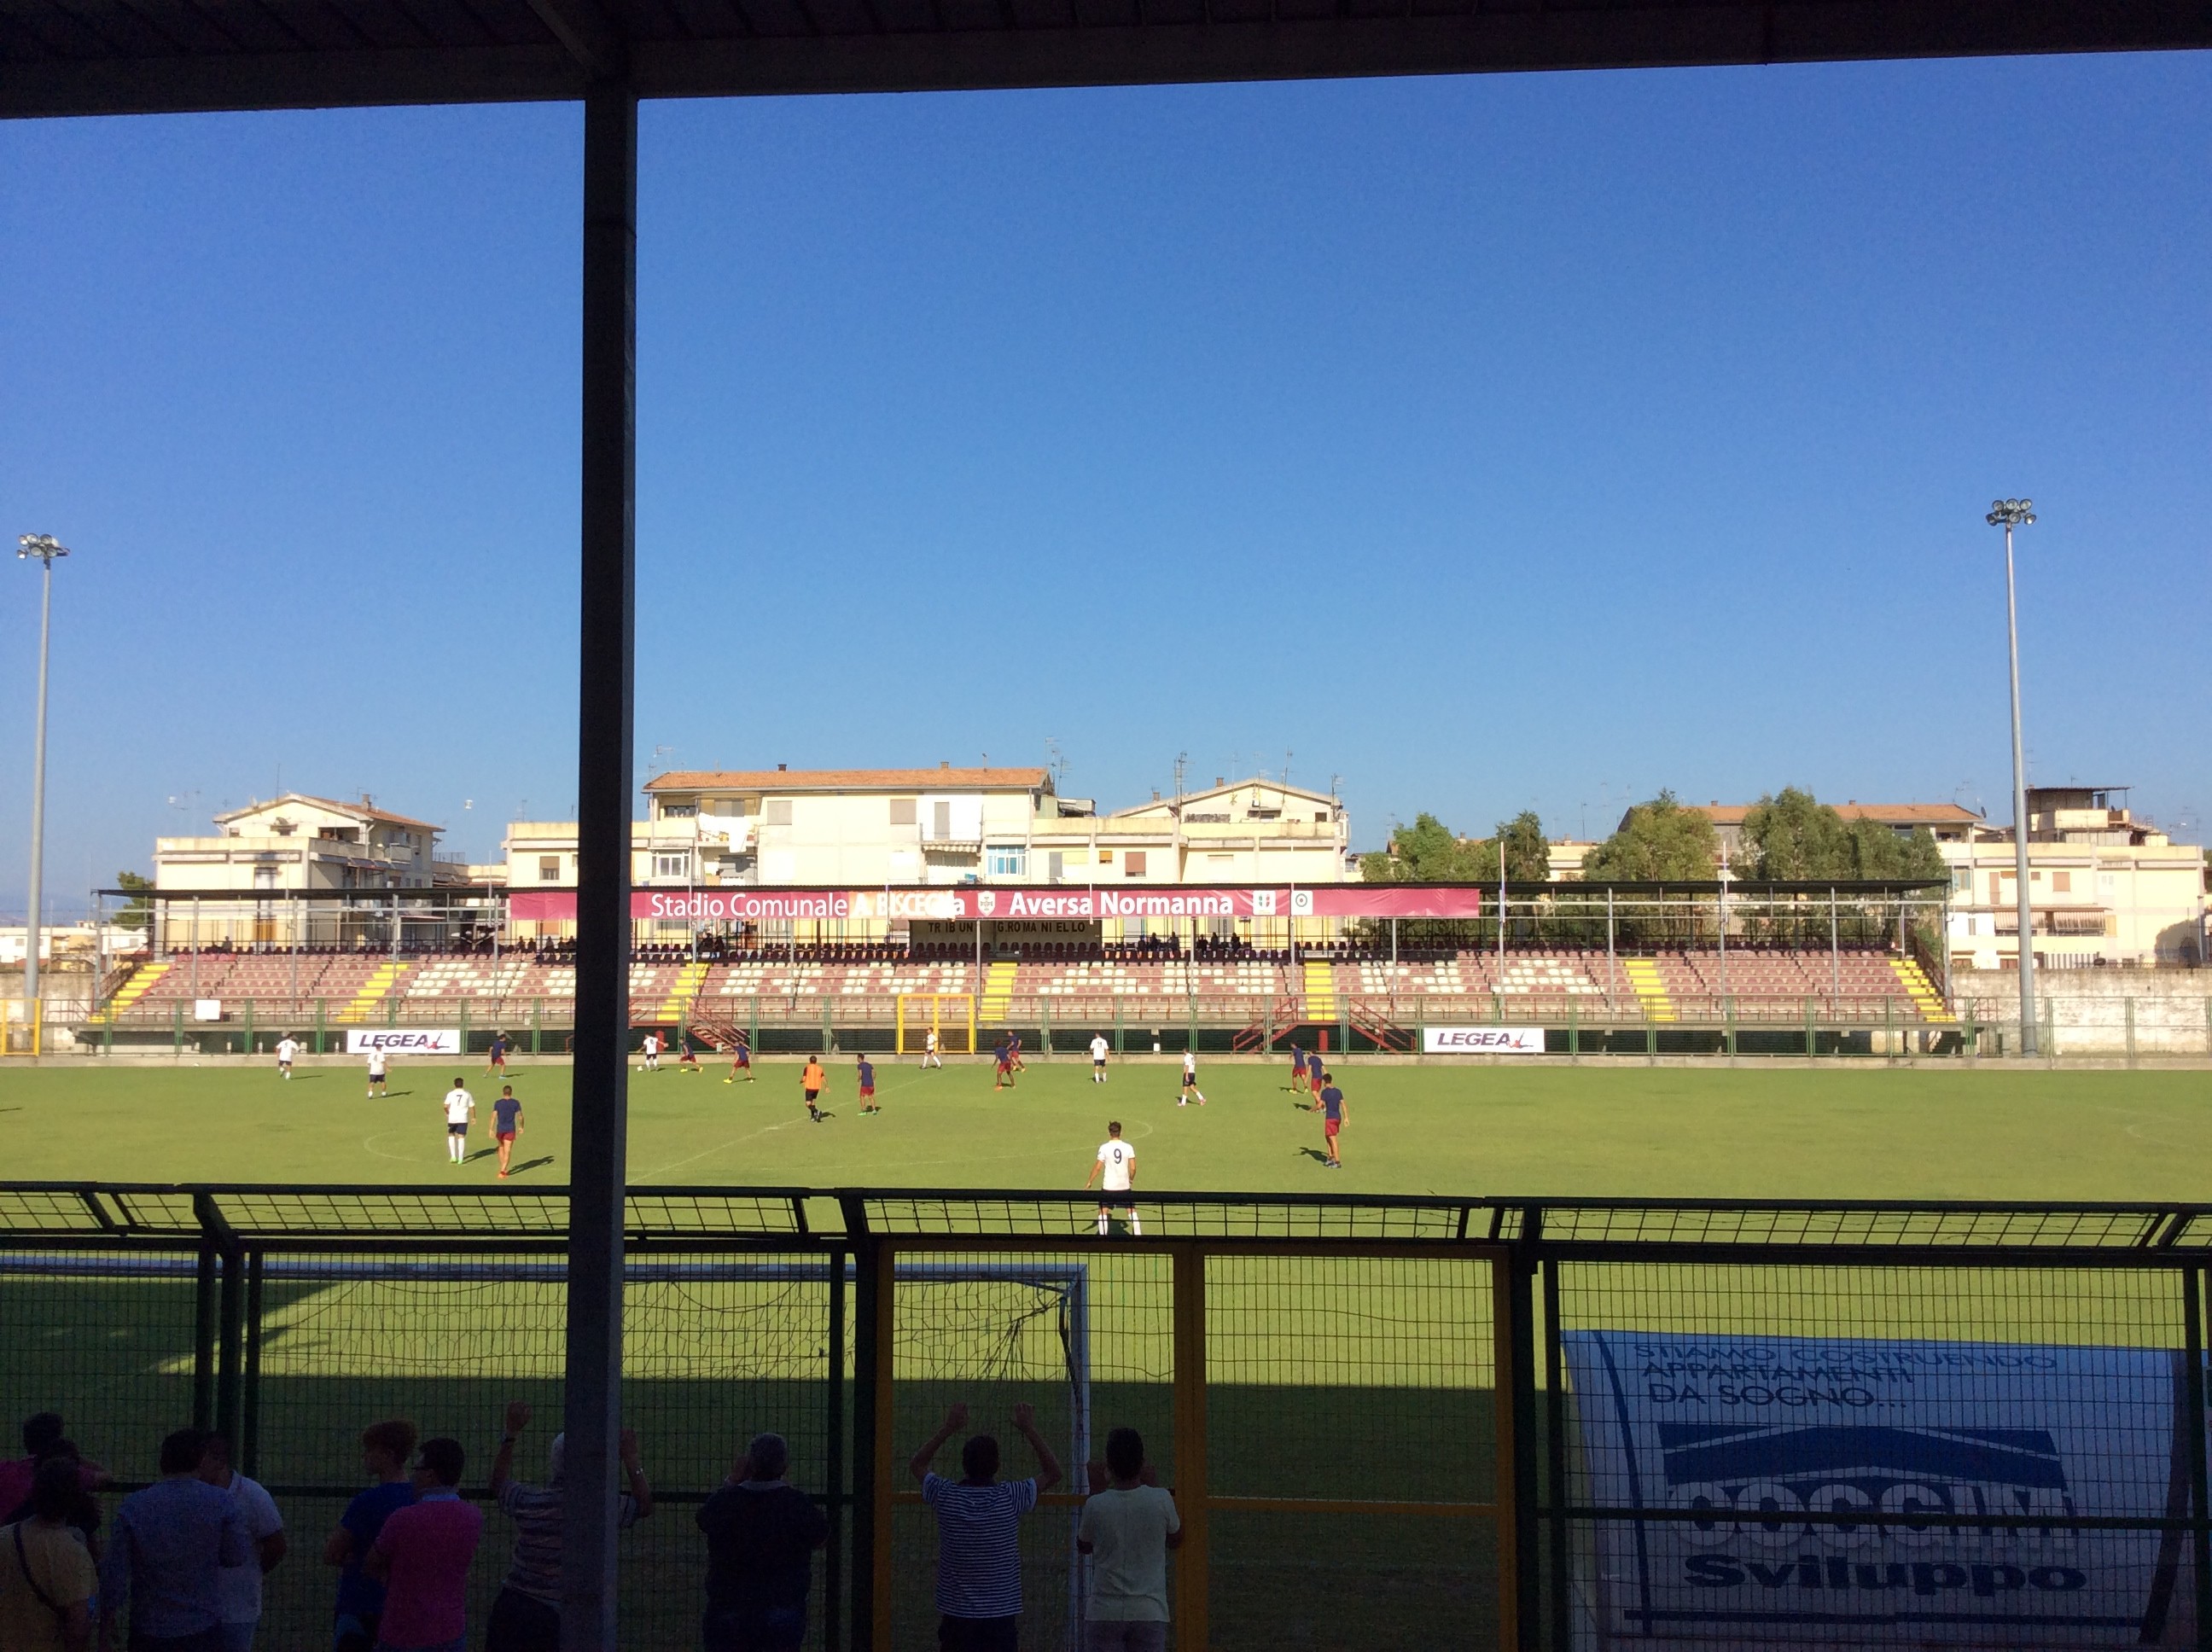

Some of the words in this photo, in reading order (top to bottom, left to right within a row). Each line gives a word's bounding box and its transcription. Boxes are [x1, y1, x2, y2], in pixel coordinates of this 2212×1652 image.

[651, 892, 725, 917] Stadio
[731, 892, 847, 917] Comunale
[1010, 892, 1092, 916] Aversa
[1100, 891, 1234, 916] Normanna
[358, 1034, 428, 1048] LEGEA
[1436, 1032, 1511, 1046] LEGEA
[456, 1094, 463, 1107] 7
[1114, 1148, 1122, 1165] 9
[1635, 1343, 1777, 1362] STIAMO
[1791, 1346, 2058, 1369] COSTRUENDO
[1642, 1361, 1913, 1384] APPARTAMENTI
[1648, 1383, 1706, 1405] DA
[1683, 1554, 2087, 1597] Sviluppo
